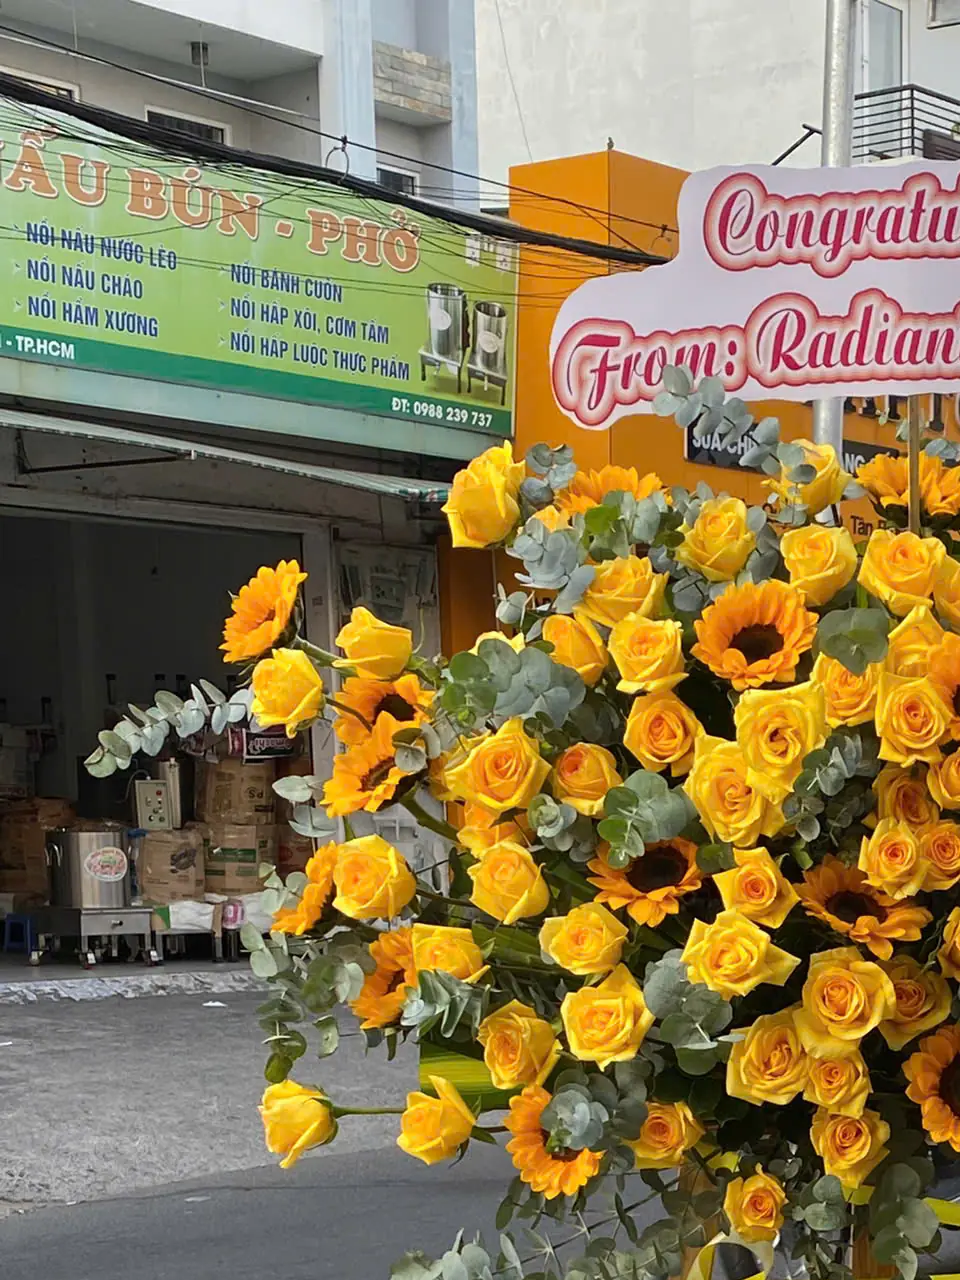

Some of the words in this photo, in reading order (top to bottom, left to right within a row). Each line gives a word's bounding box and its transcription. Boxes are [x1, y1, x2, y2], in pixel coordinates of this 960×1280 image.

[0, 124, 110, 206] ẤU
[125, 167, 263, 240] BÚN
[305, 207, 421, 272] PHỞ
[101, 272, 143, 300] CHÁO
[104, 307, 158, 338] XƯƠNG
[326, 315, 356, 340] CƠM
[15, 334, 75, 360] TP.HCM
[293, 341, 328, 369] LUỘC
[333, 350, 367, 376] THỰC
[565, 333, 740, 411] From:
[391, 396, 410, 413] ĐT:
[413, 401, 443, 420] 0988
[446, 407, 468, 424] 239
[471, 411, 493, 428] 737
